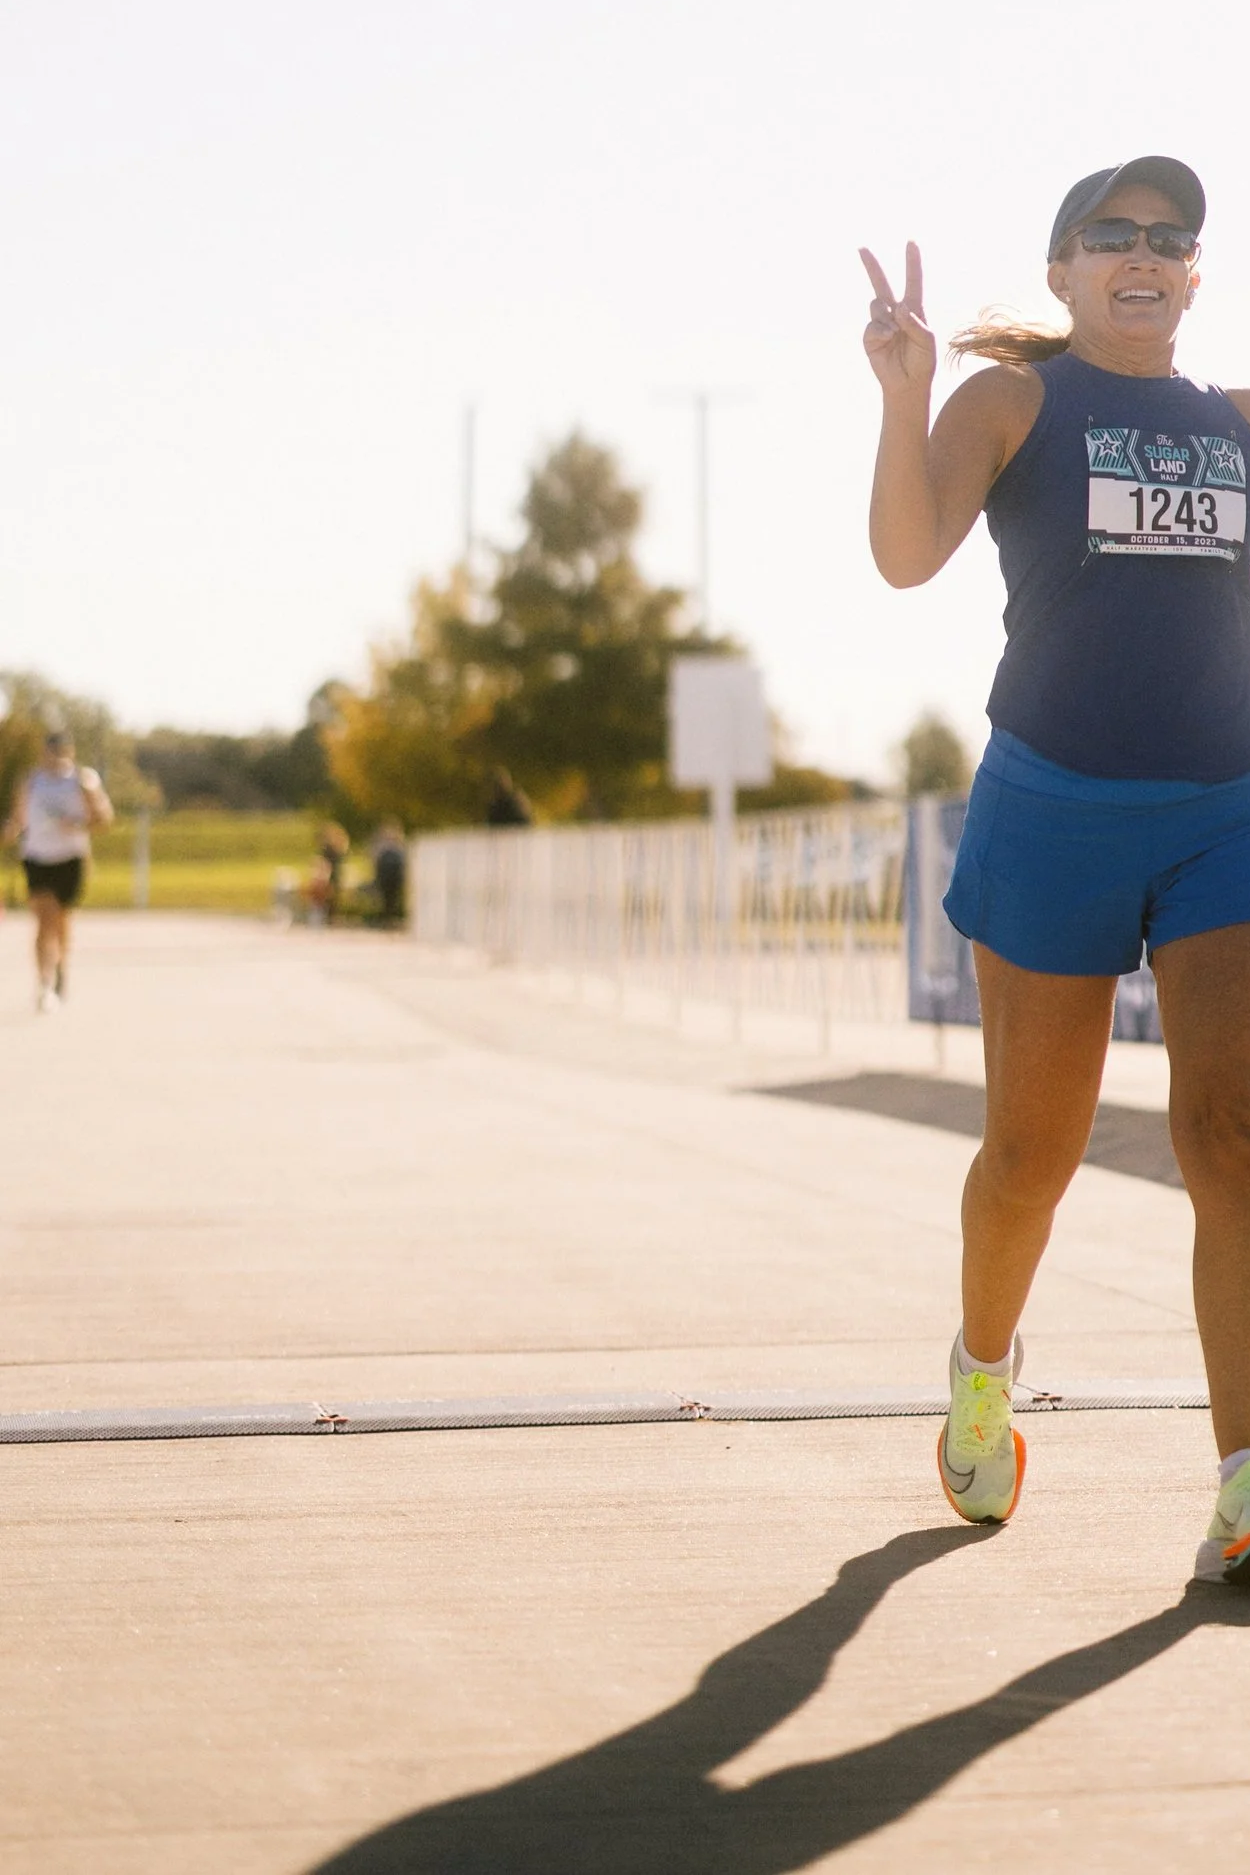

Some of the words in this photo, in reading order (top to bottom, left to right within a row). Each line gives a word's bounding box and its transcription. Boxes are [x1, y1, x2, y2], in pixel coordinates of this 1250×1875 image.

[1156, 434, 1175, 446] The
[1143, 444, 1191, 462] SUGAR
[1150, 458, 1187, 475] LAND
[1160, 473, 1179, 482] HALF
[1129, 486, 1219, 535] 1243
[1130, 535, 1170, 544] OCTOBER
[1176, 536, 1188, 545] 15,
[1194, 537, 1217, 546] 2023
